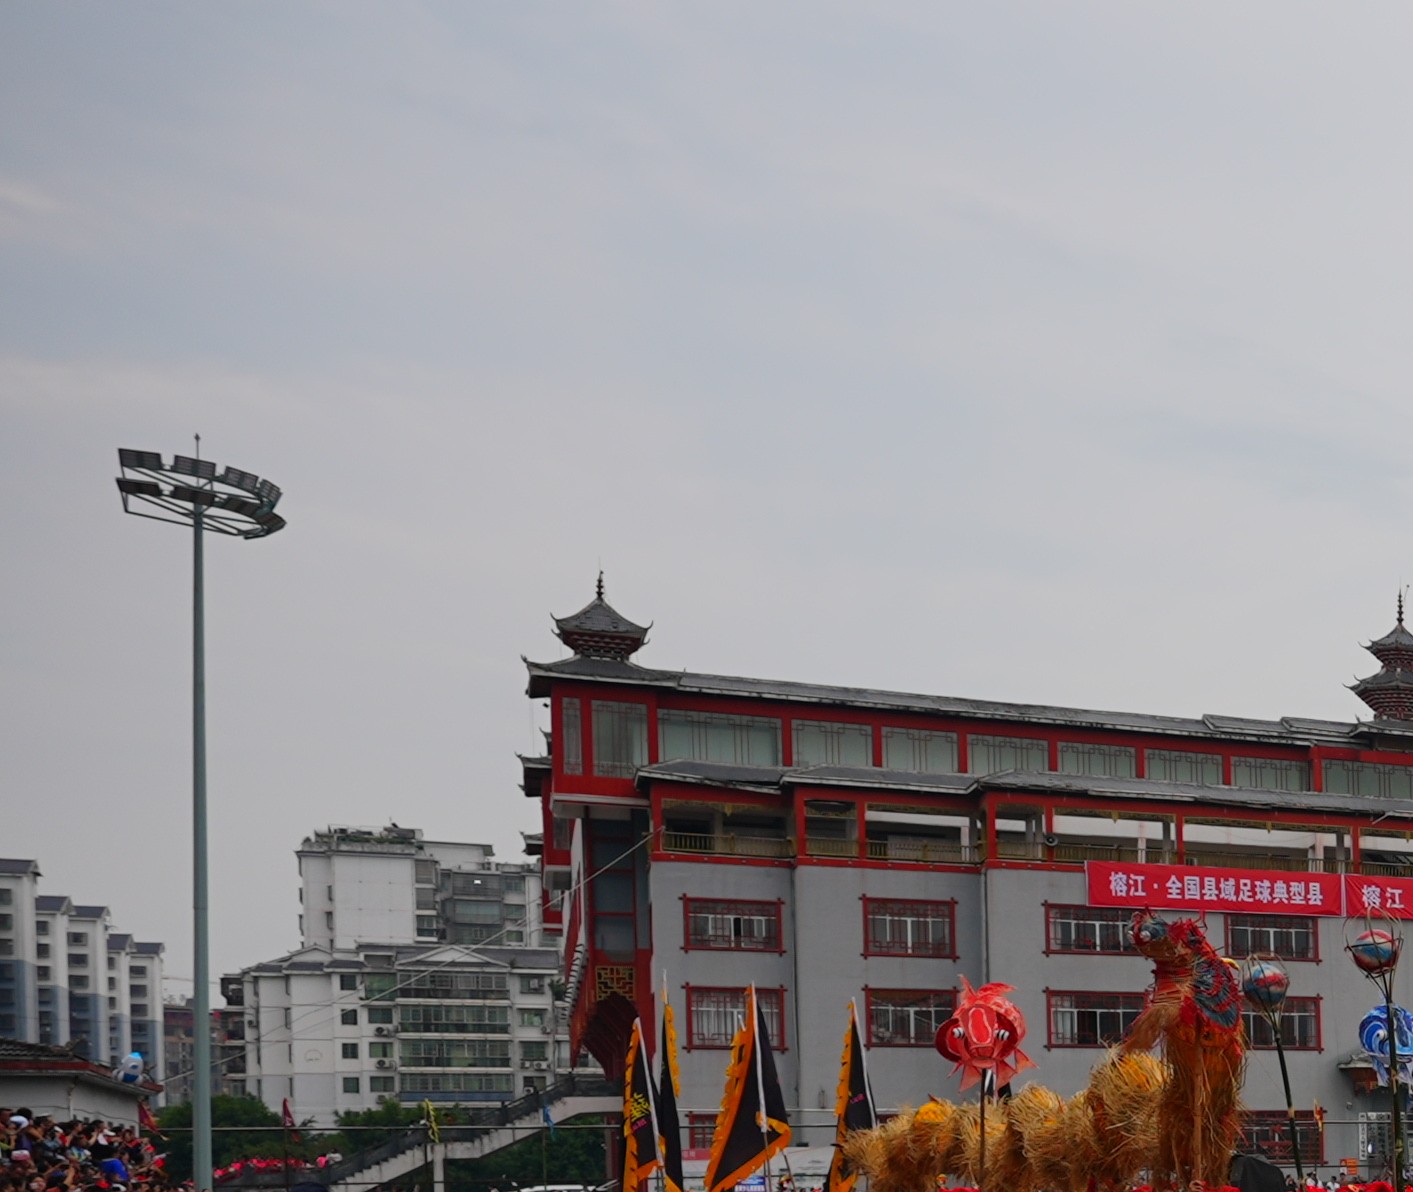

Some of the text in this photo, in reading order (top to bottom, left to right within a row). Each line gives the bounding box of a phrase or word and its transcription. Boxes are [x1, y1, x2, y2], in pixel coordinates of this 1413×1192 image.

[1109, 871, 1323, 905] 榕江·全国县域足球典型县
